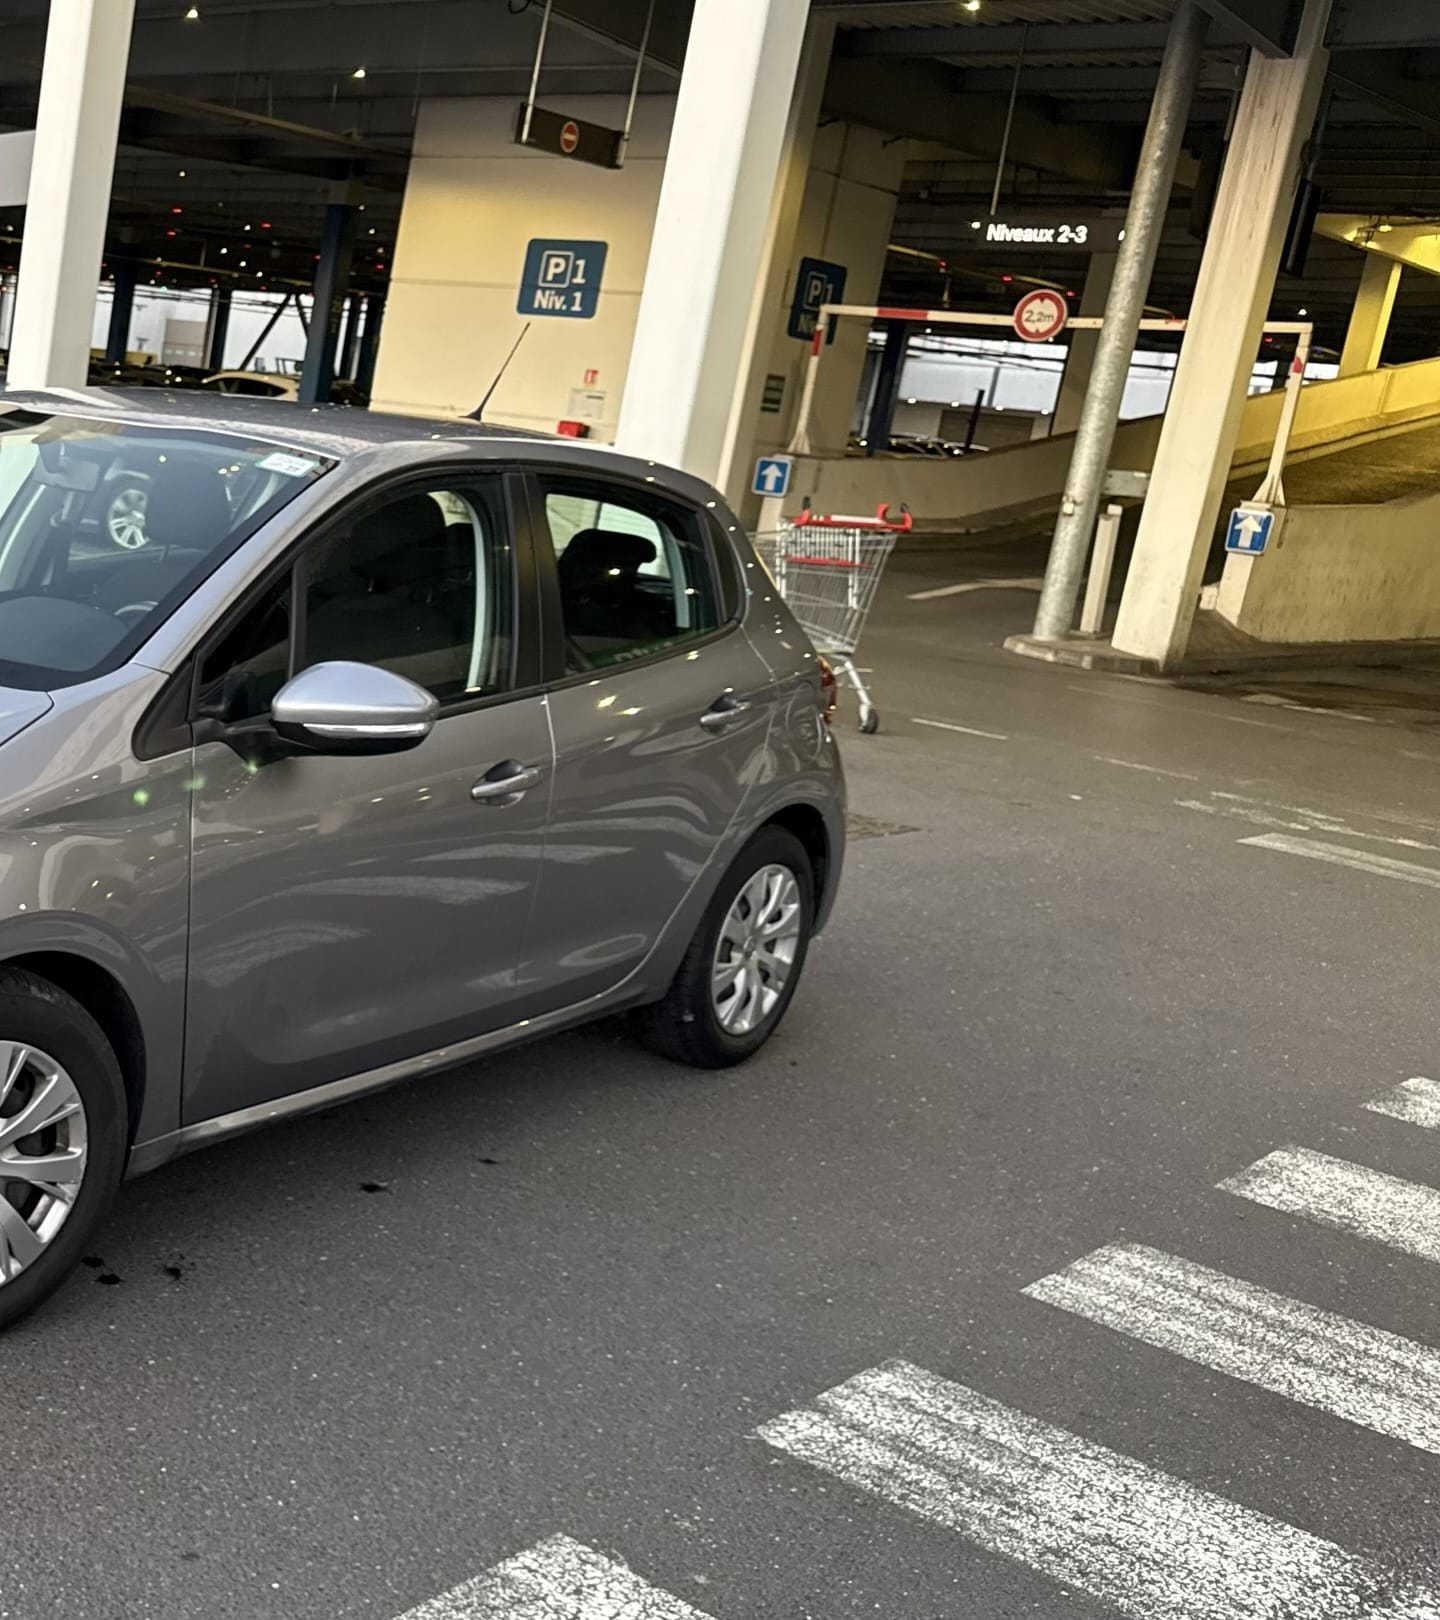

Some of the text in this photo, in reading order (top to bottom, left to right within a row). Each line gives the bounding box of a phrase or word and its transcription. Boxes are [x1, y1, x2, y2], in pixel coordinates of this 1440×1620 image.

[986, 223, 1088, 244] Niveaux 2-3
[533, 289, 582, 312] Niv. 1
